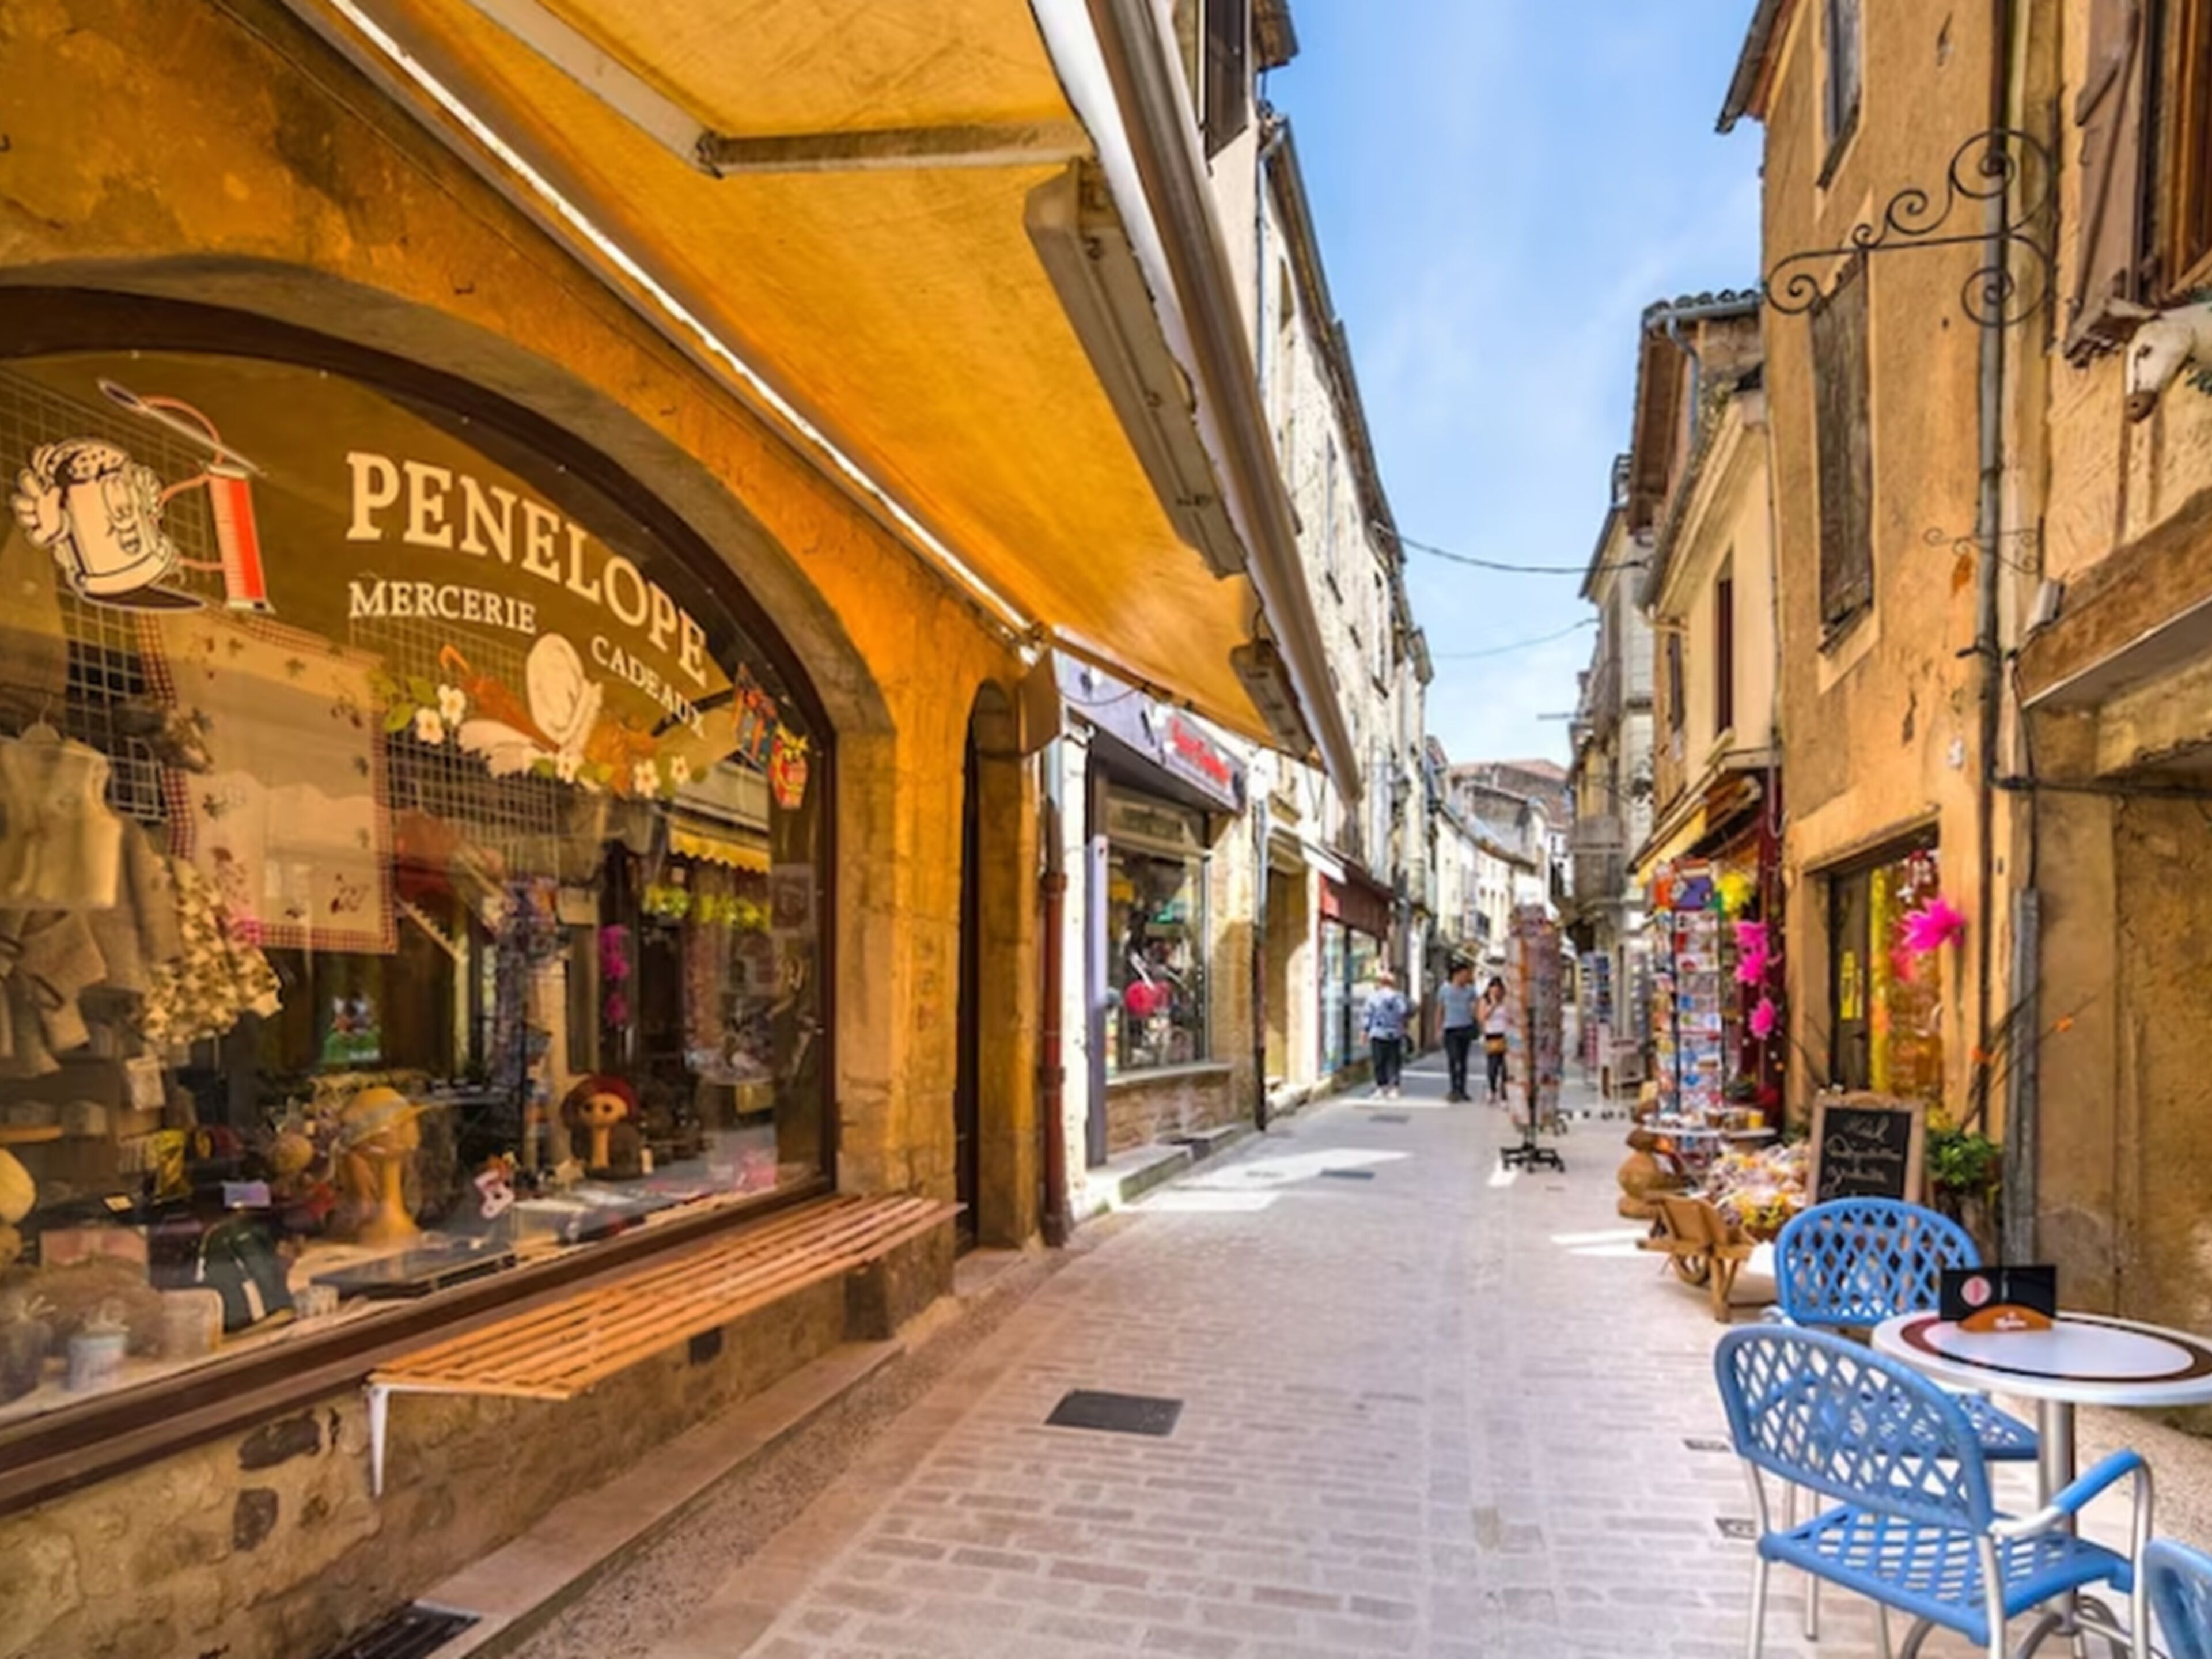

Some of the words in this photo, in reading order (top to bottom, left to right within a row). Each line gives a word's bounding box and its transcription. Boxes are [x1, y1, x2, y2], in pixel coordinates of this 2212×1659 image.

[346, 452, 706, 687] PENELOPE
[348, 581, 537, 634] MERCERIE
[591, 635, 704, 738] CADEAUX
